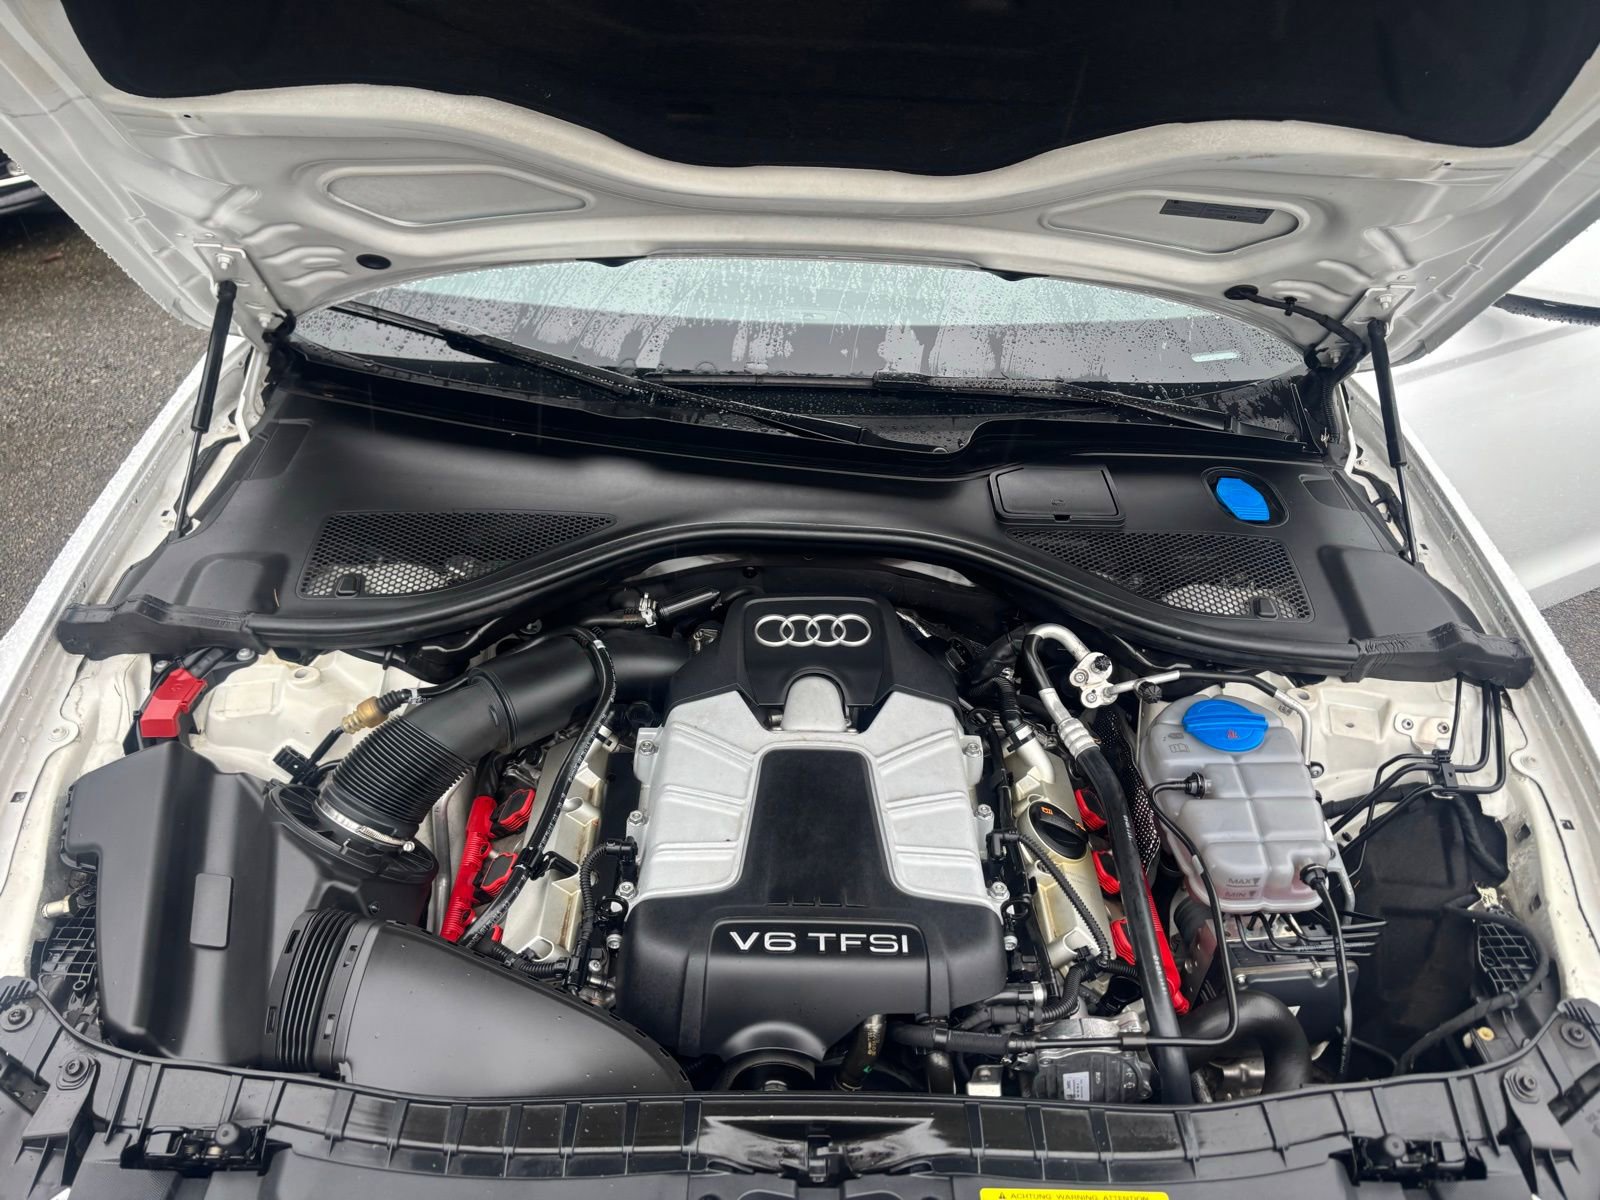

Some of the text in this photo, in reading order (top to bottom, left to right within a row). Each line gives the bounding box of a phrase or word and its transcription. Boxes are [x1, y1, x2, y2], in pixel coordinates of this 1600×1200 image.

[1228, 877, 1251, 885] MAX
[1225, 890, 1247, 898] MIN
[729, 931, 909, 953] V6 TFSI
[1011, 1192, 1052, 1200] ACHTUNG
